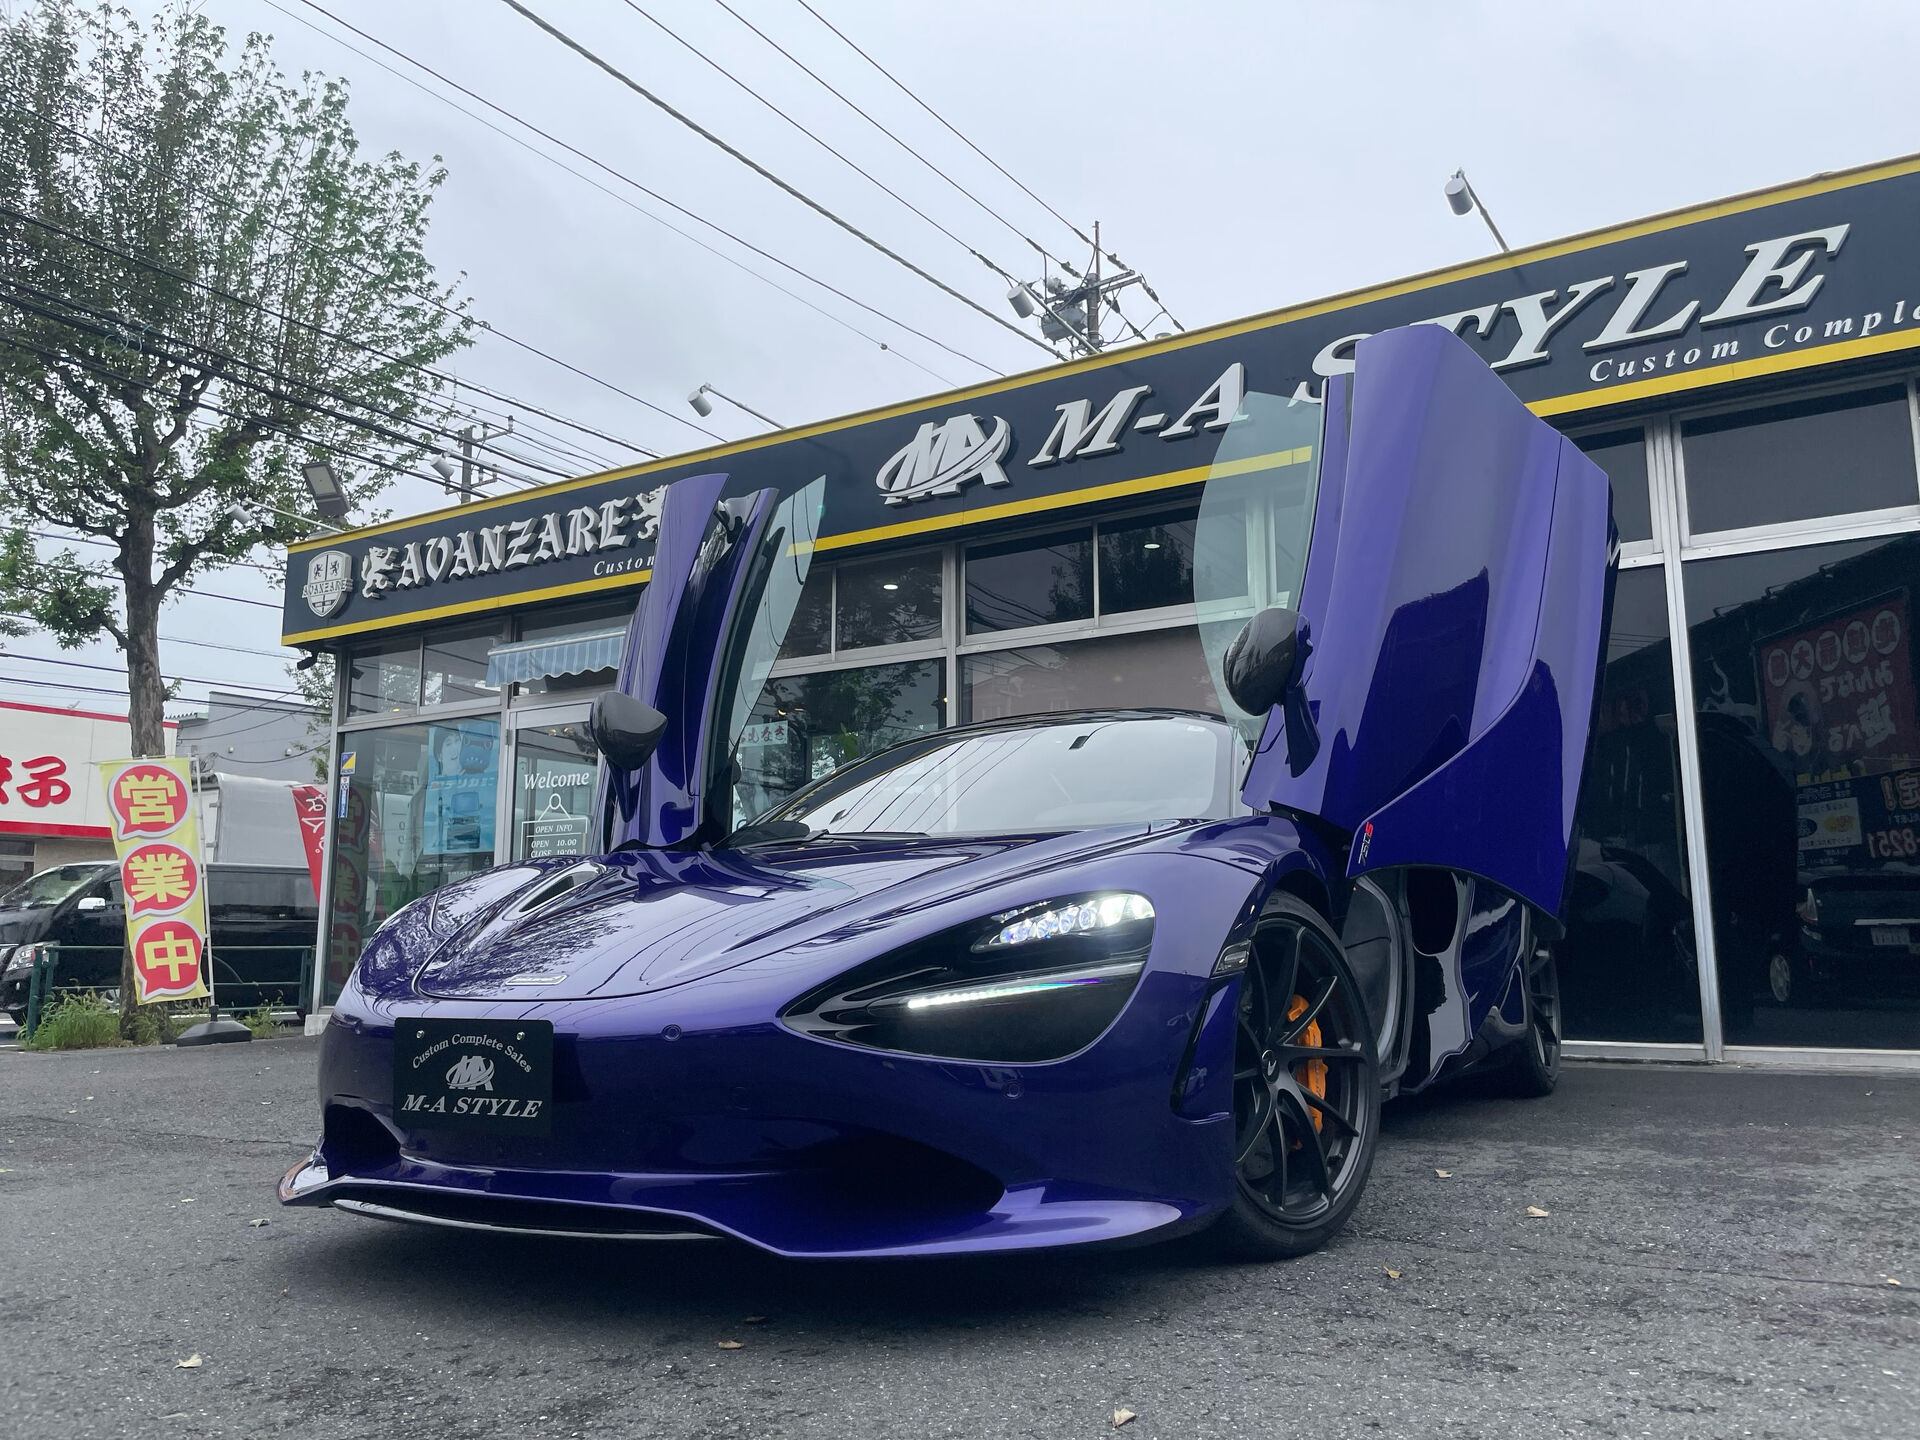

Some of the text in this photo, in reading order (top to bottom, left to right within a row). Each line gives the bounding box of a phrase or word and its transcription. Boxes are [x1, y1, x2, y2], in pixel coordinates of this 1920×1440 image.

[1589, 340, 1740, 384] Custom
[1027, 362, 1249, 467] M-A
[523, 770, 590, 790] Welcome
[531, 840, 550, 849] OPEN
[535, 823, 573, 834] OPEN INFO
[120, 774, 198, 982] 営業中
[412, 1033, 533, 1073] Custom Complete Sales
[401, 1094, 543, 1118] M-A STYLE
